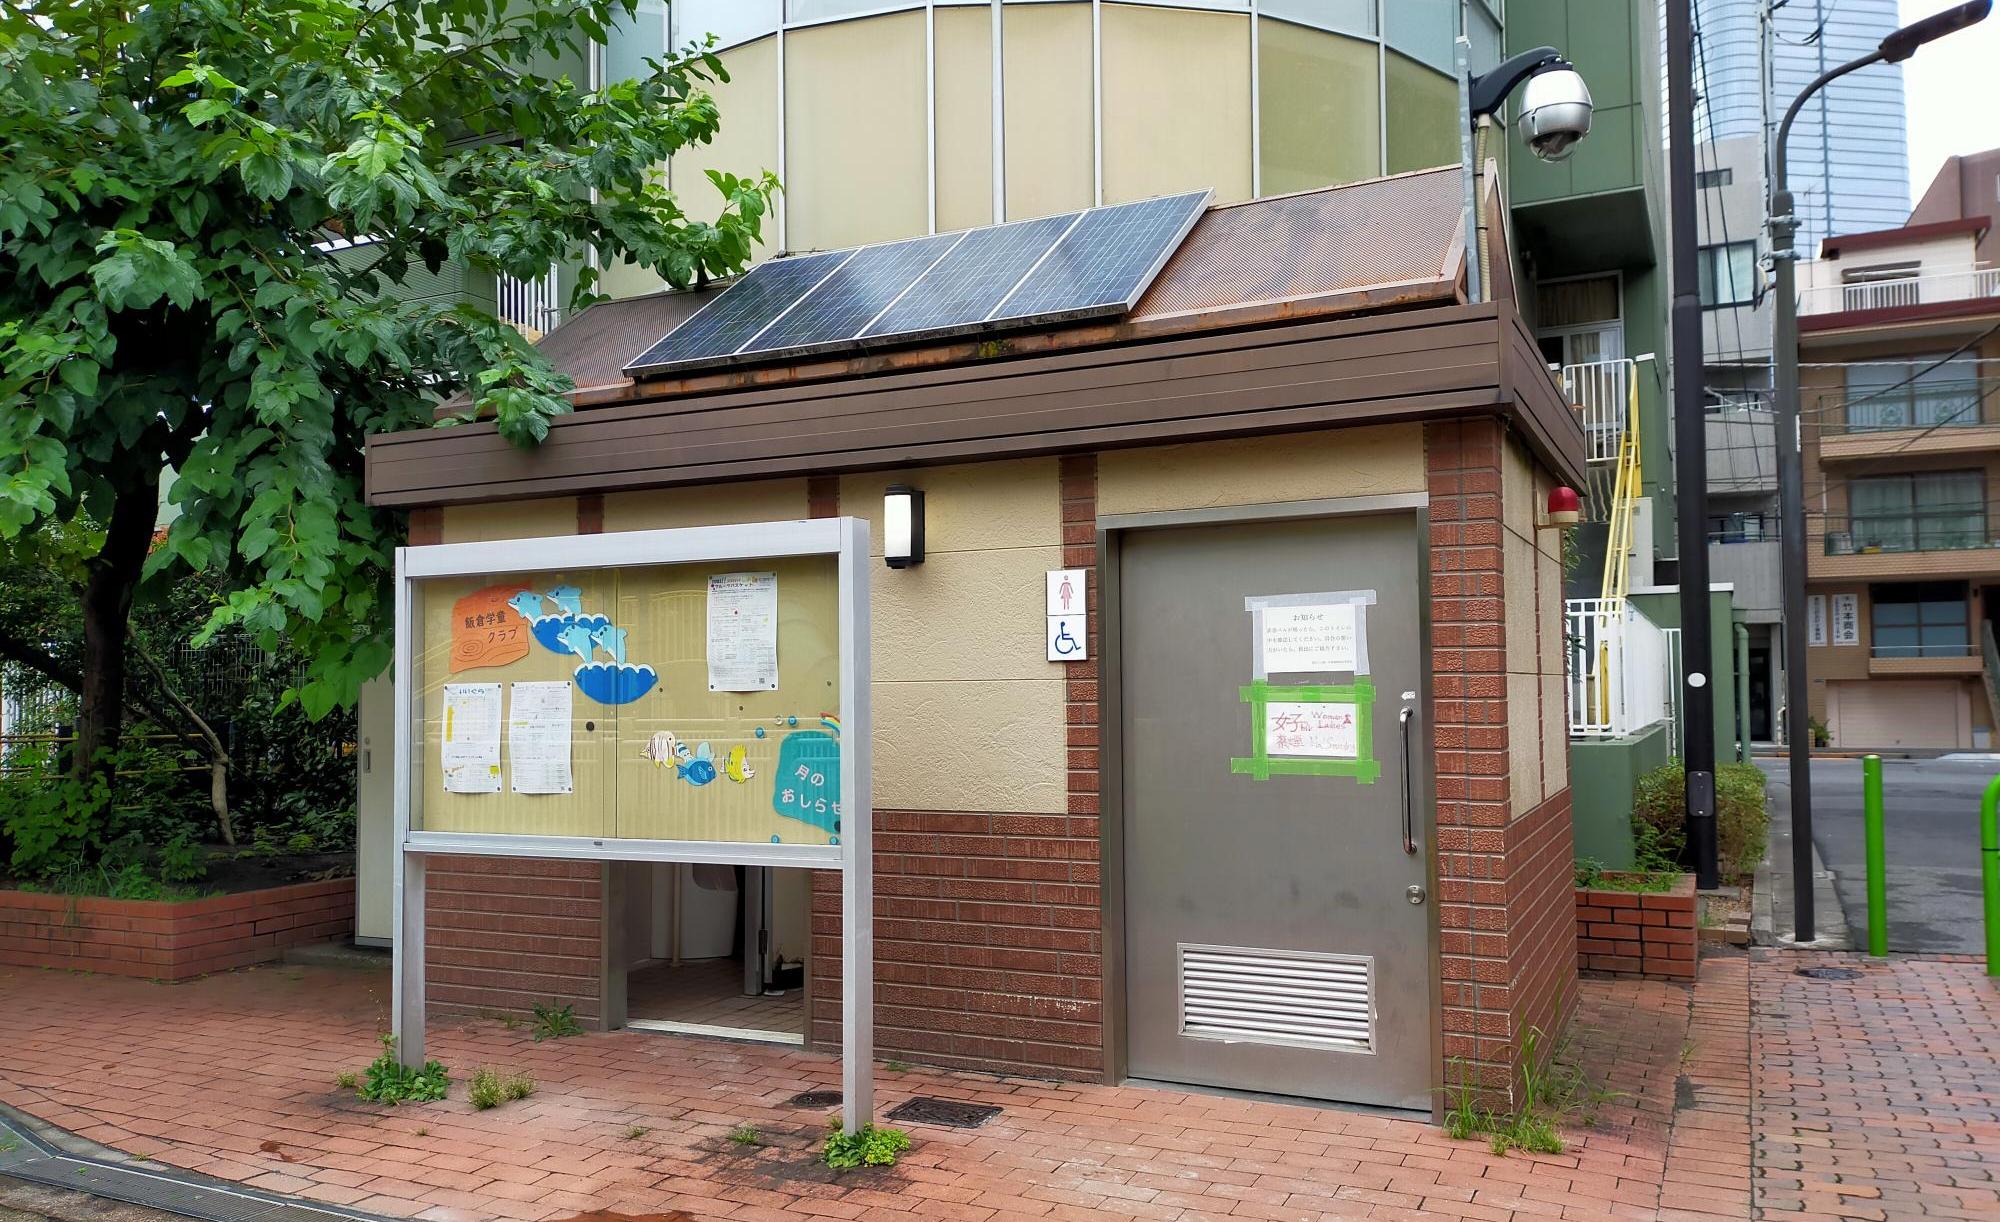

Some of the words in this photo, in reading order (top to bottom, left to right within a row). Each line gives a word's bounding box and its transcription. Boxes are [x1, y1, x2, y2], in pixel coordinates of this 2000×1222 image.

[465, 610, 507, 629] 飯倉学童
[1293, 613, 1324, 621] お知らせ
[488, 626, 518, 644] クラブ
[794, 764, 825, 786] 月の
[781, 788, 841, 815] おしらせ
